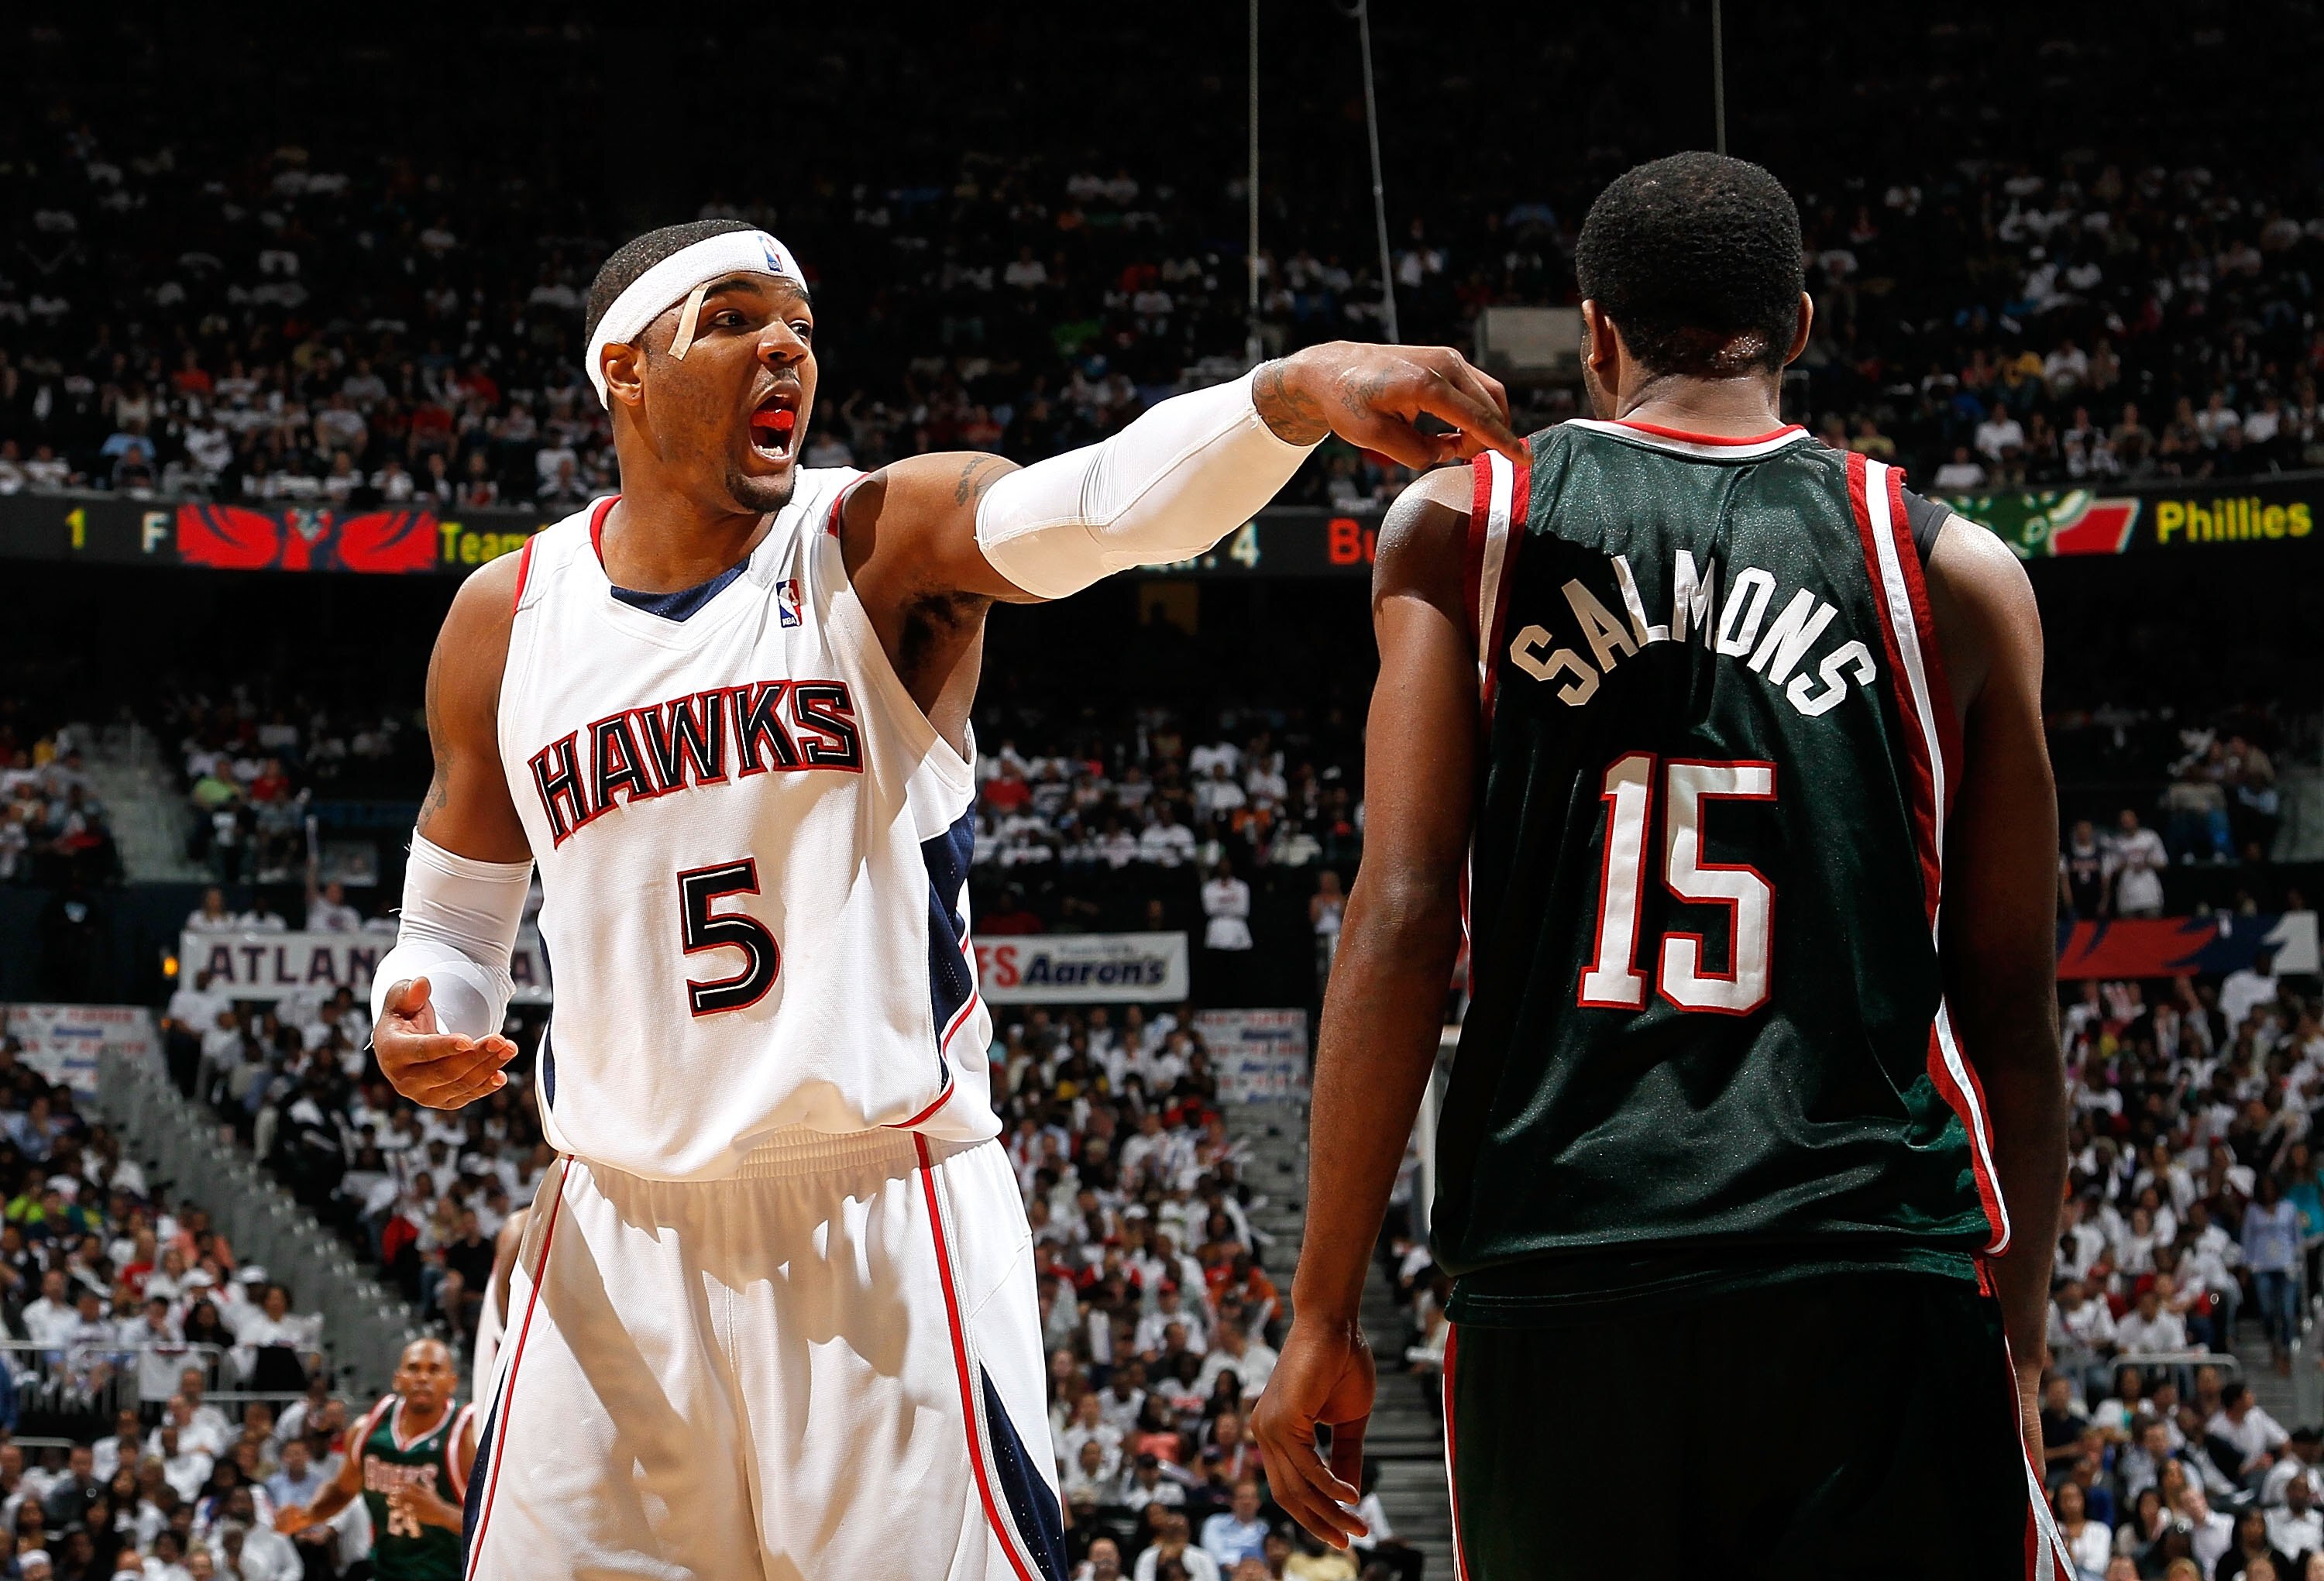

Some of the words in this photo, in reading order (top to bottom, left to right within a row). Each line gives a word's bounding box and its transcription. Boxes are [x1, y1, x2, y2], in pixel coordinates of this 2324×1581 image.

[65, 507, 86, 550] 1
[143, 510, 170, 553] F
[1230, 521, 1260, 569] 4
[2157, 497, 2313, 545] Phillies
[1510, 549, 1877, 717] SALMONS
[528, 679, 864, 850] HAWKS
[1576, 750, 1778, 1016] 15
[677, 857, 781, 1018] 5
[208, 946, 375, 985] ATLAN
